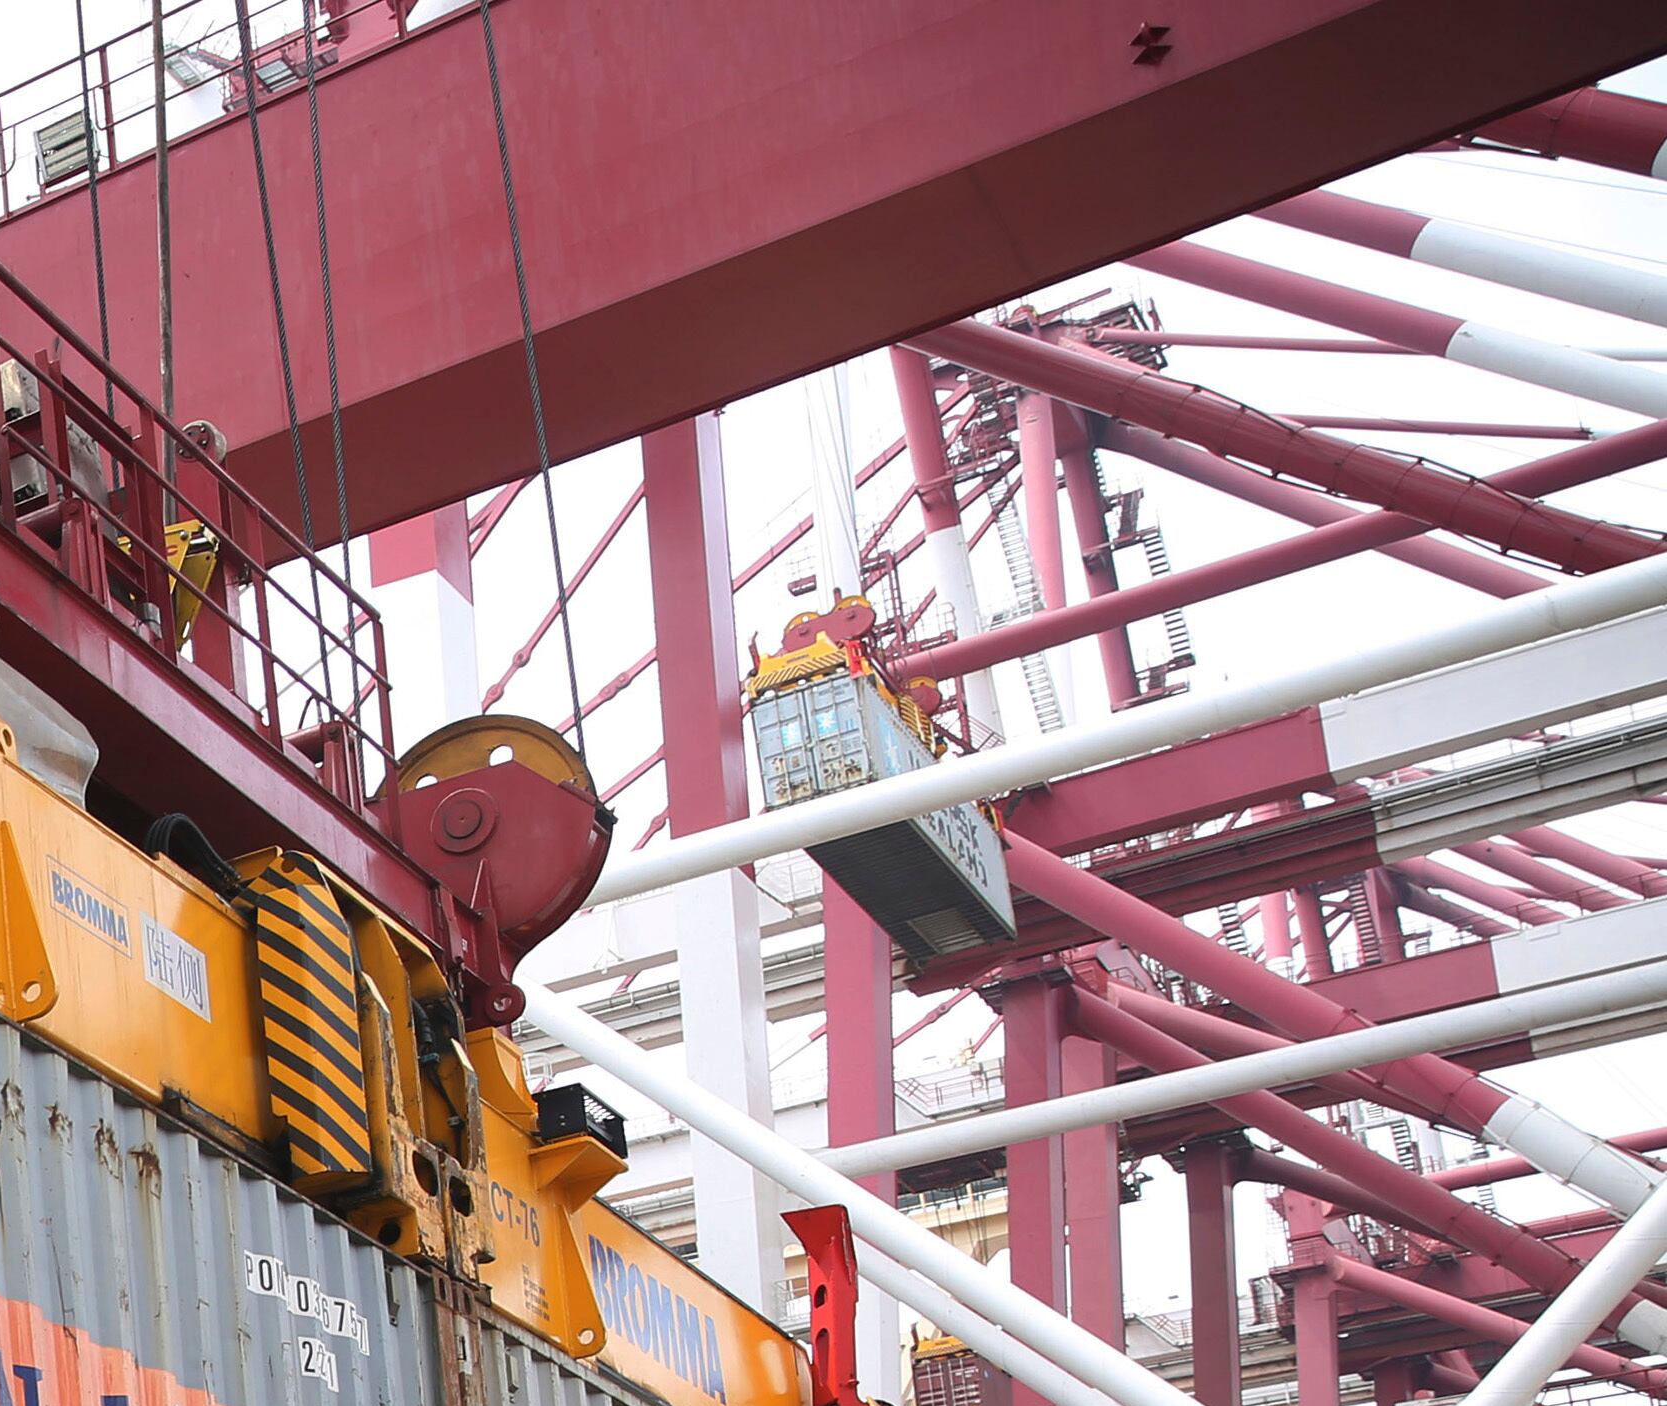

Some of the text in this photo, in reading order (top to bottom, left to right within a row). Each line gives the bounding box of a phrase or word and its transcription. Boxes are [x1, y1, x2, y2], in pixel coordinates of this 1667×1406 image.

[51, 870, 130, 948] BROMMA
[490, 1181, 541, 1247] CT-76
[587, 1233, 728, 1406] BROMMA
